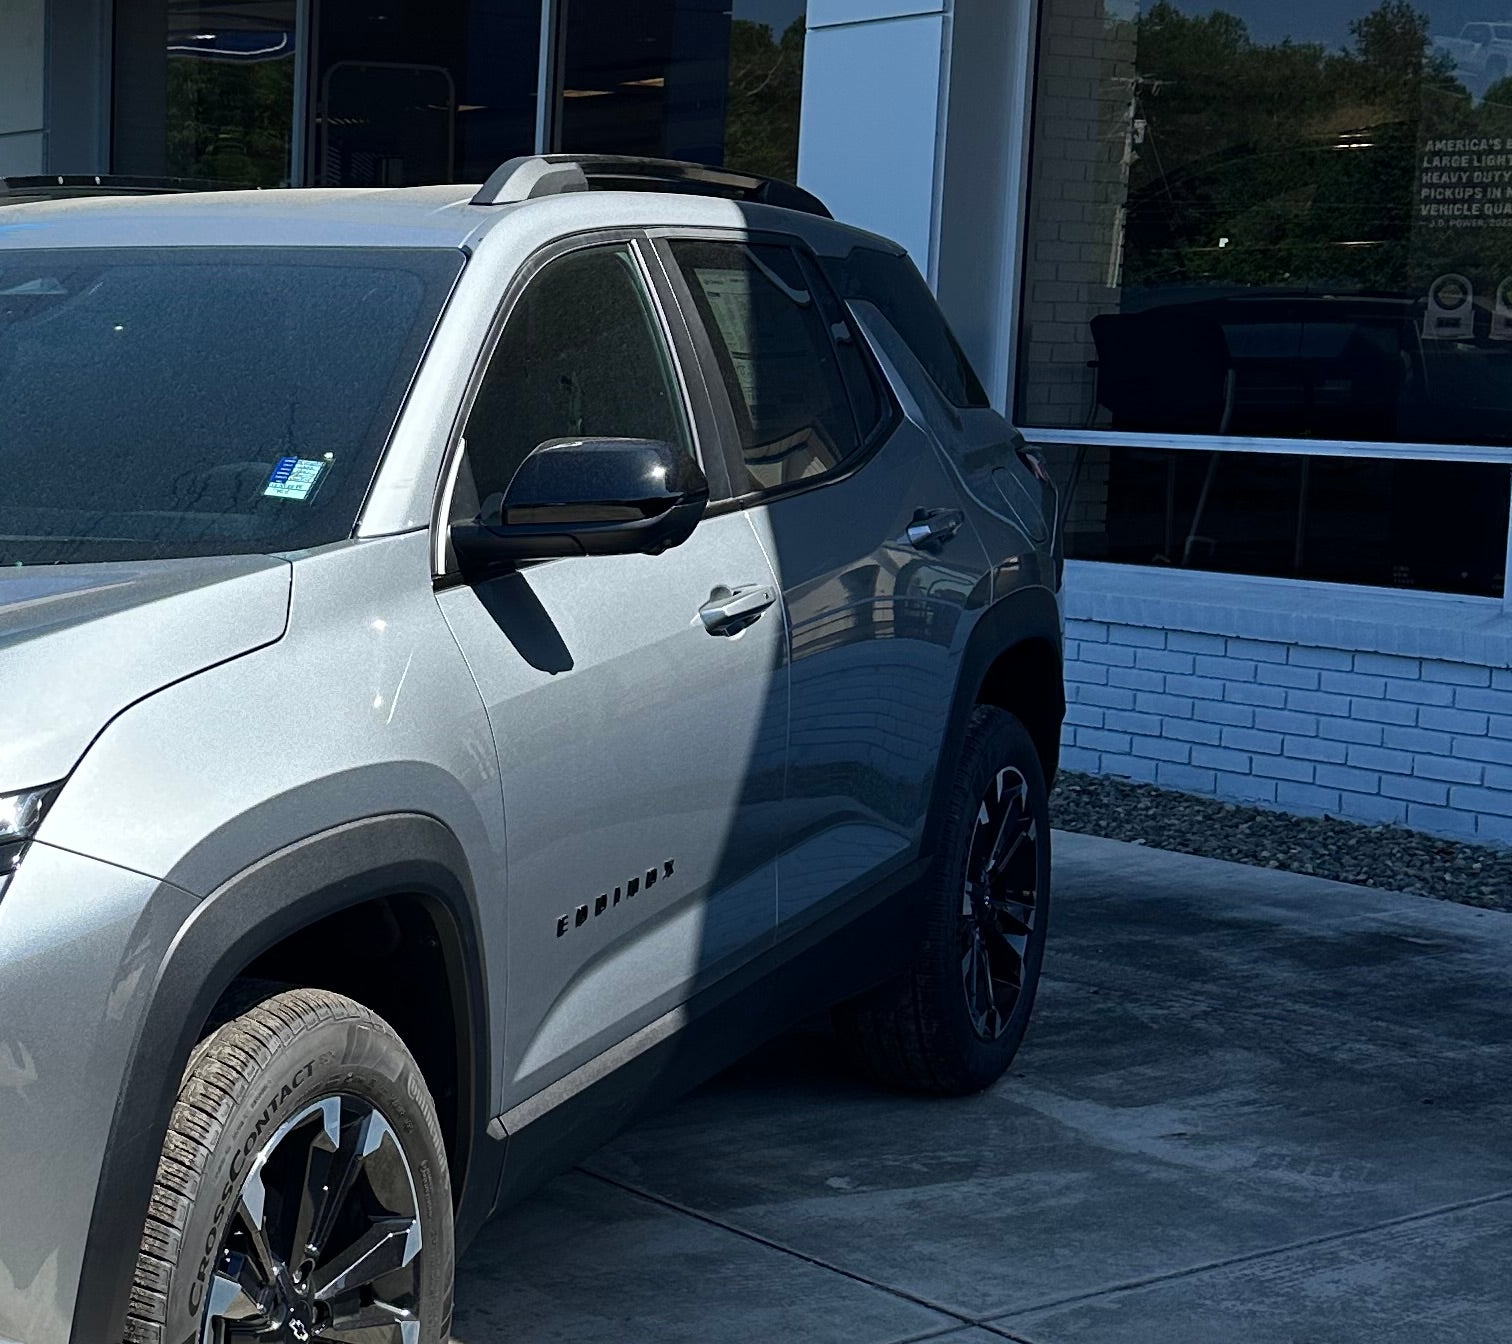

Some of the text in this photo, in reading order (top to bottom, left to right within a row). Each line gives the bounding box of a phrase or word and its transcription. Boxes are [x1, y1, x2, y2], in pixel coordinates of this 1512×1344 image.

[1425, 138, 1501, 151] AMERICA'S
[1423, 155, 1469, 167] LARGE
[1422, 171, 1511, 183] HEAVY DUTY
[1421, 188, 1483, 199] PICKUPS
[1487, 187, 1501, 198] IN
[1420, 204, 1481, 215] VEHICLE
[556, 857, 675, 938] EQUINOX
